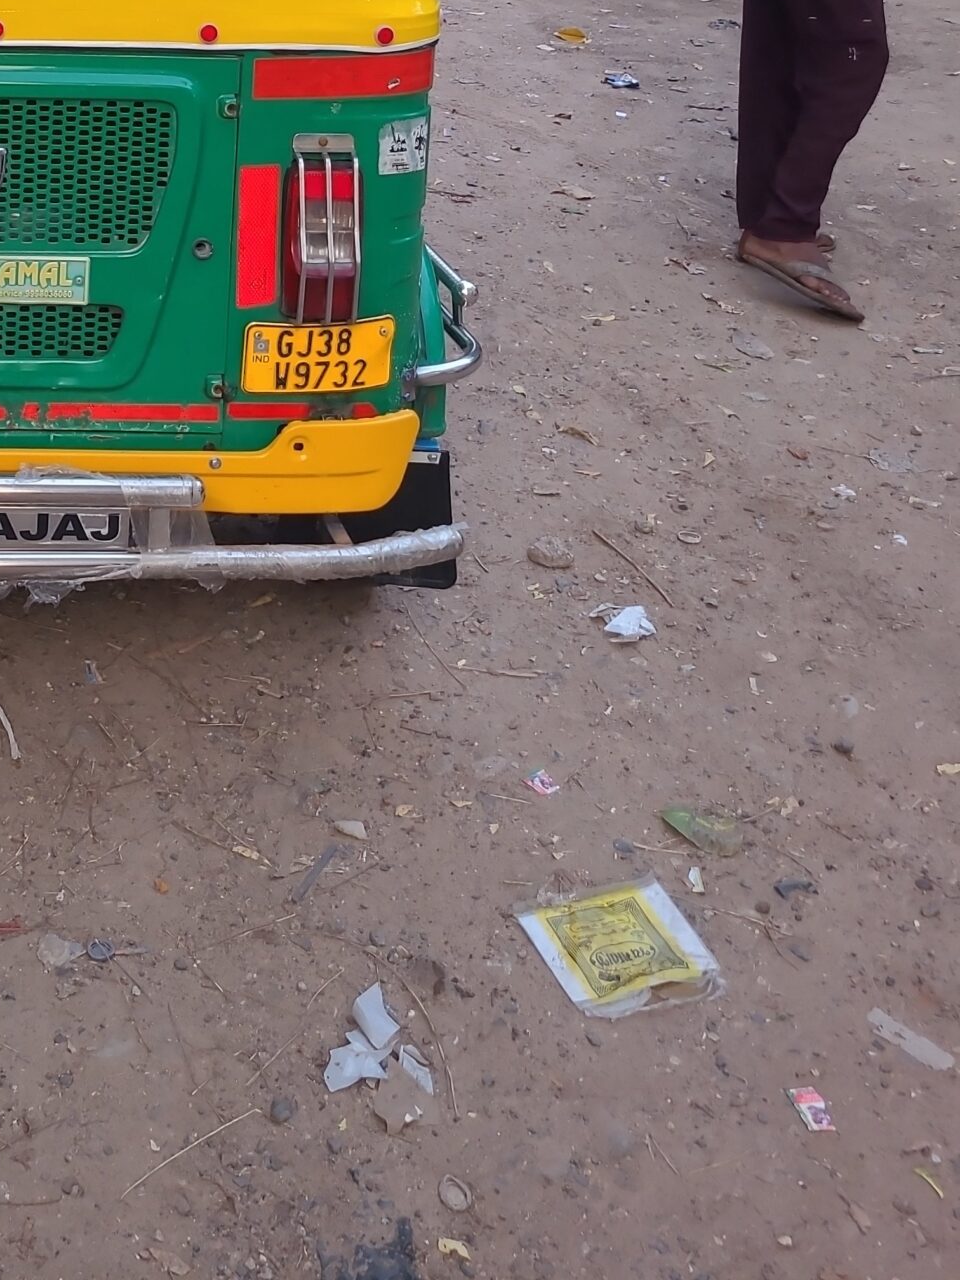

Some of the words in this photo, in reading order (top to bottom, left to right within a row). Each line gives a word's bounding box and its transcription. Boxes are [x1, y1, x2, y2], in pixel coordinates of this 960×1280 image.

[277, 328, 352, 358] GJ38
[252, 354, 271, 364] IND
[275, 359, 367, 390] W9732
